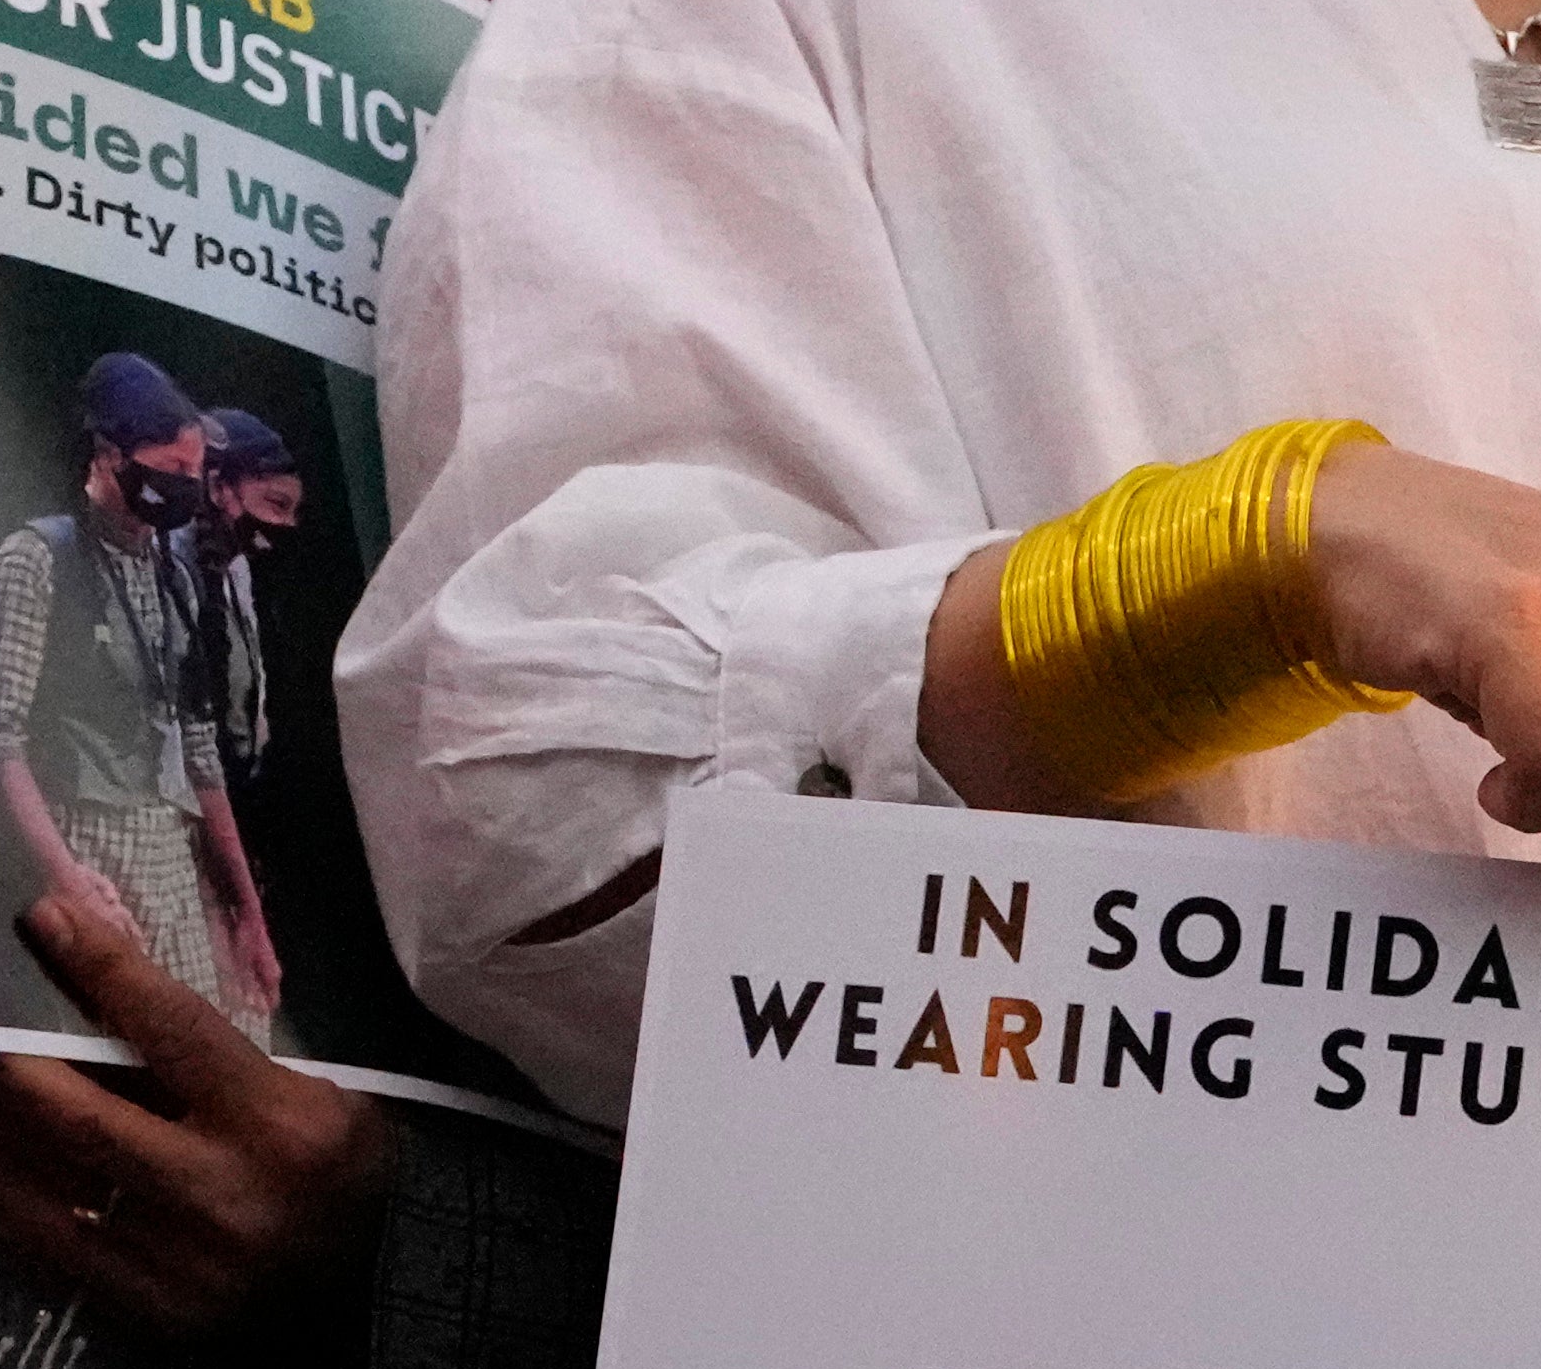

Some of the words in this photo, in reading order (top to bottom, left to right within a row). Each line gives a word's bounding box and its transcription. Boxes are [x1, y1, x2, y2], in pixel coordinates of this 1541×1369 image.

[26, 168, 175, 258] Dirty
[194, 231, 377, 326] politic
[226, 167, 345, 253] we
[916, 873, 1030, 964] IN
[730, 974, 1255, 1101] WEARING
